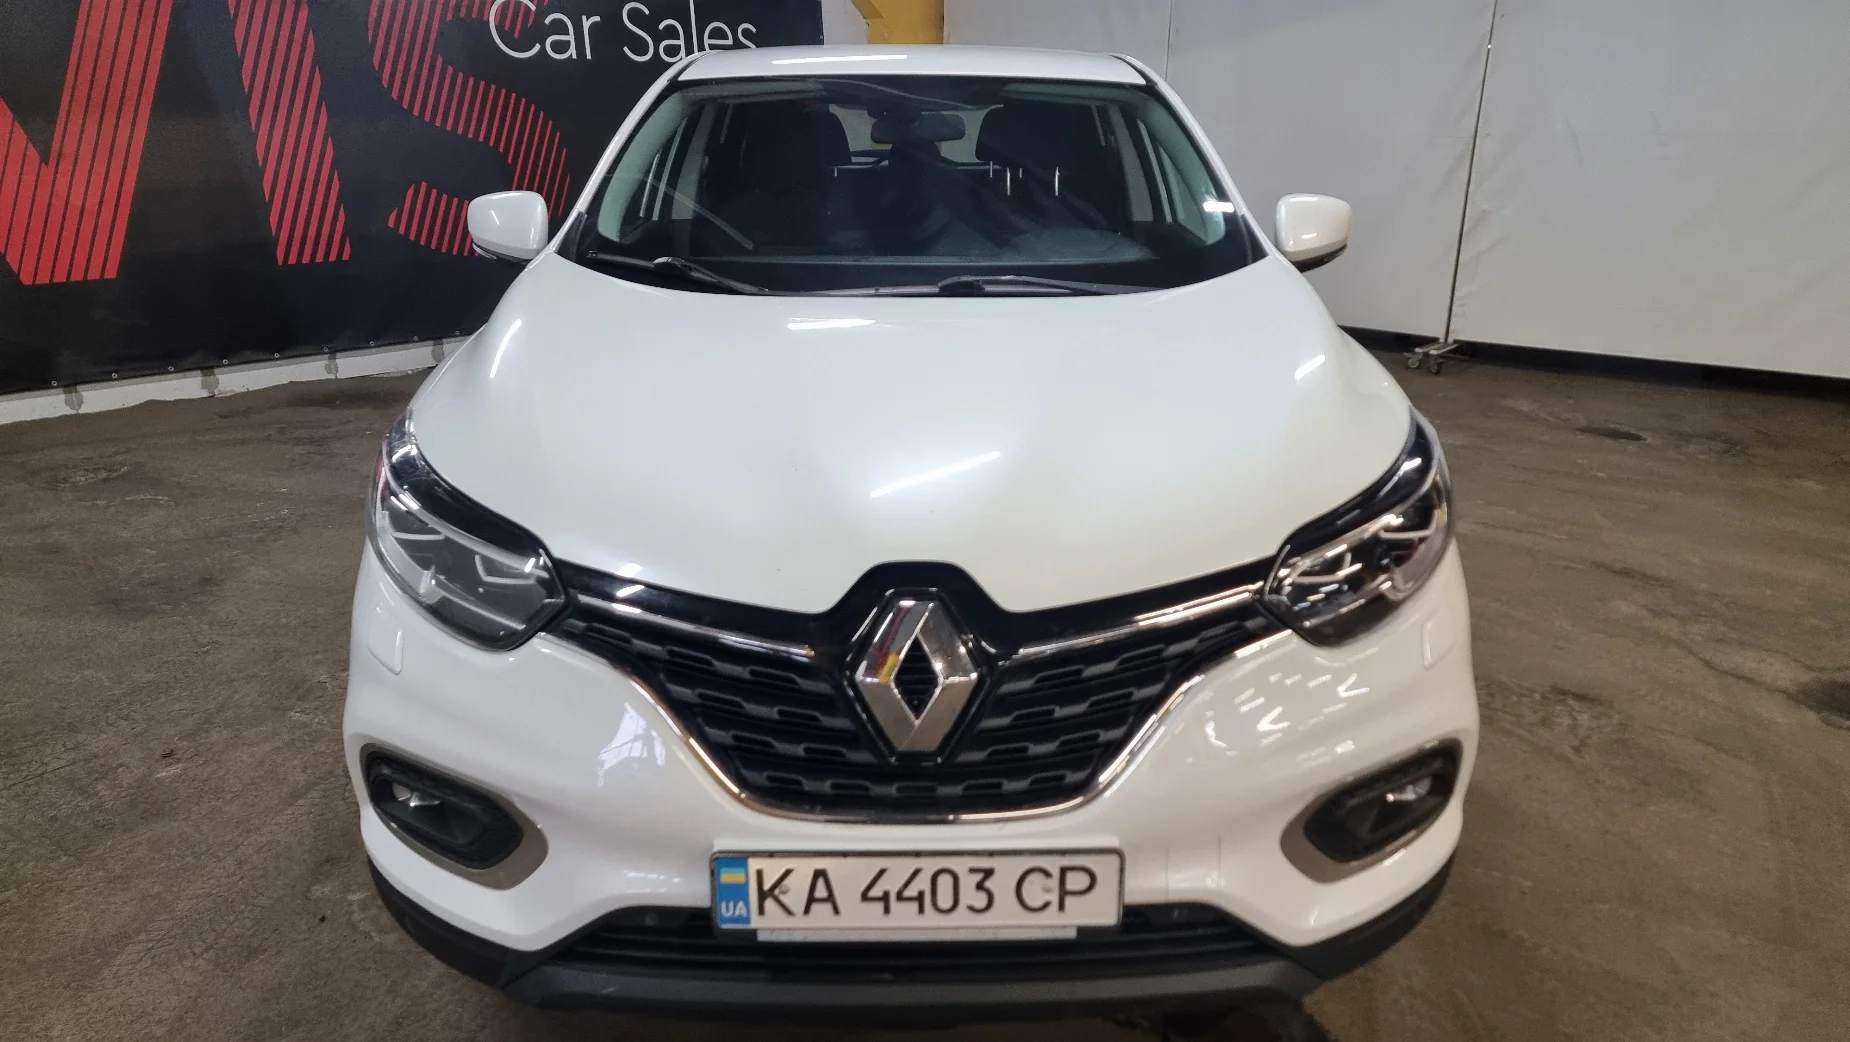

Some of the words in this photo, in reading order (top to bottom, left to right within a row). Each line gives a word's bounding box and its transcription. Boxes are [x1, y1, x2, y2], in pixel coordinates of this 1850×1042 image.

[489, 0, 601, 59] Car
[622, 0, 757, 62] Sales
[720, 899, 749, 918] UA
[756, 868, 840, 916] KA
[860, 867, 996, 915] 4403
[1015, 866, 1097, 913] CP
